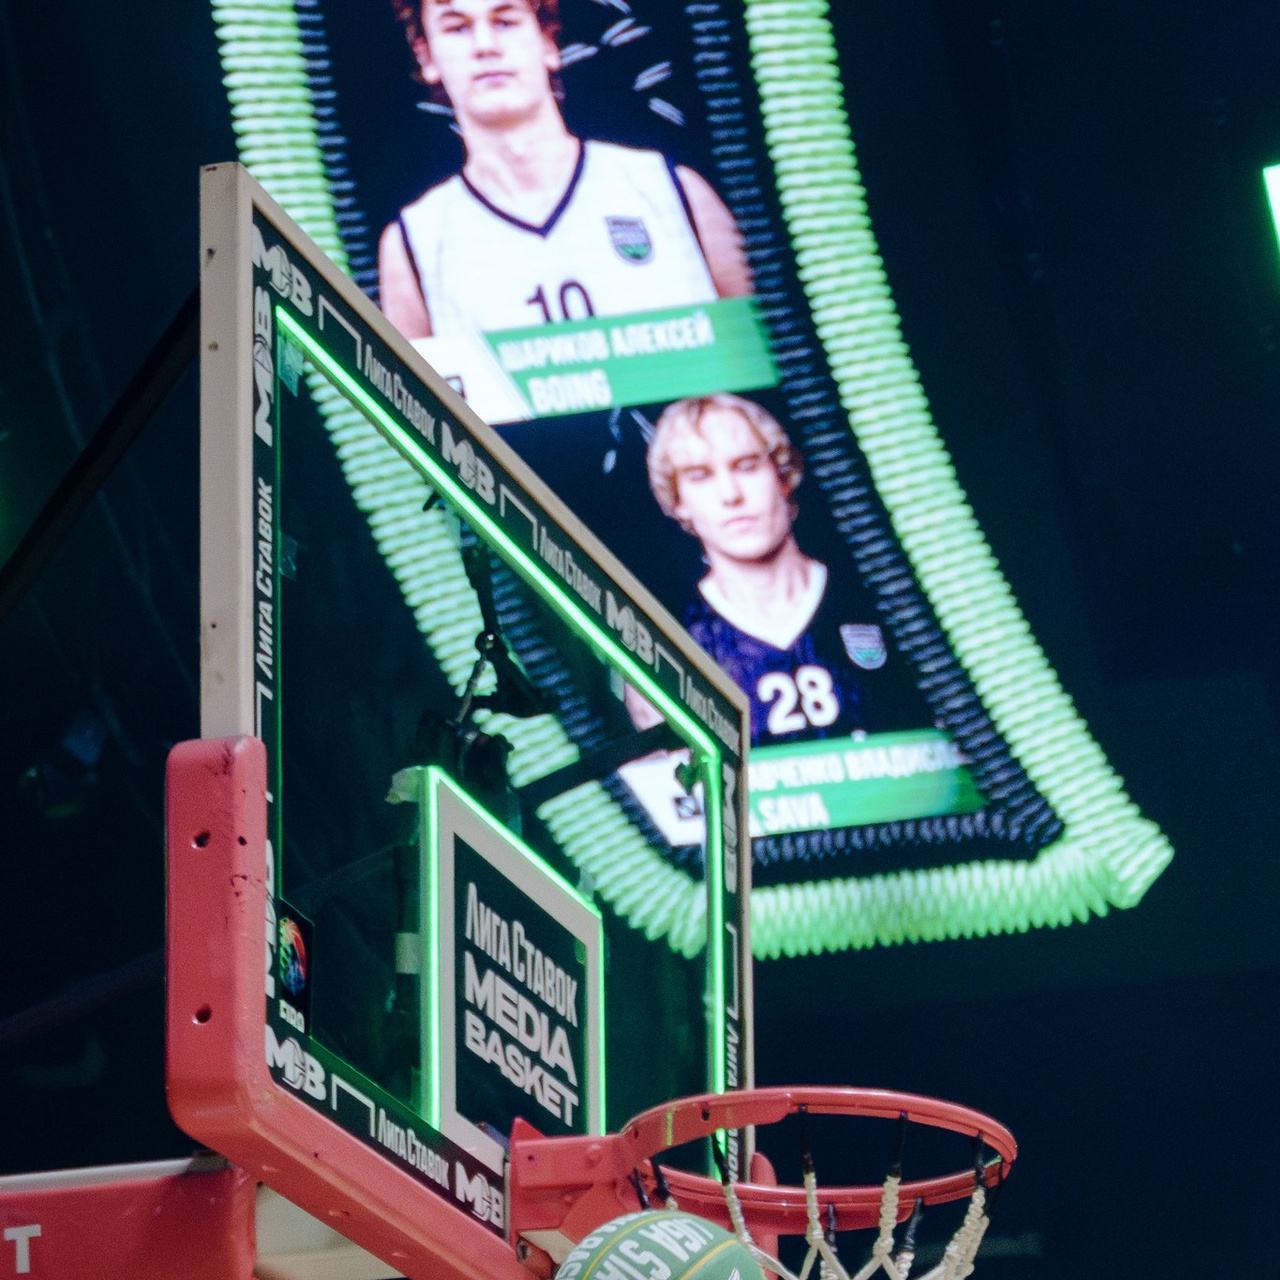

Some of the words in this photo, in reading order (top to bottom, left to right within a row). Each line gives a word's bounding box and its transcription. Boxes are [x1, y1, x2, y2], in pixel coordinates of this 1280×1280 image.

[610, 311, 714, 358] АЛЕКСЕЙ
[527, 368, 612, 414] BOING
[256, 483, 273, 598] СТАВОК
[256, 602, 273, 680] ЛИГА
[757, 665, 839, 734] 28
[759, 792, 828, 832] SAVA
[465, 882, 511, 973] ЛИГА
[513, 920, 578, 1028] СТАВОК
[465, 950, 578, 1087] MEDIA
[465, 1009, 579, 1127] BASKET
